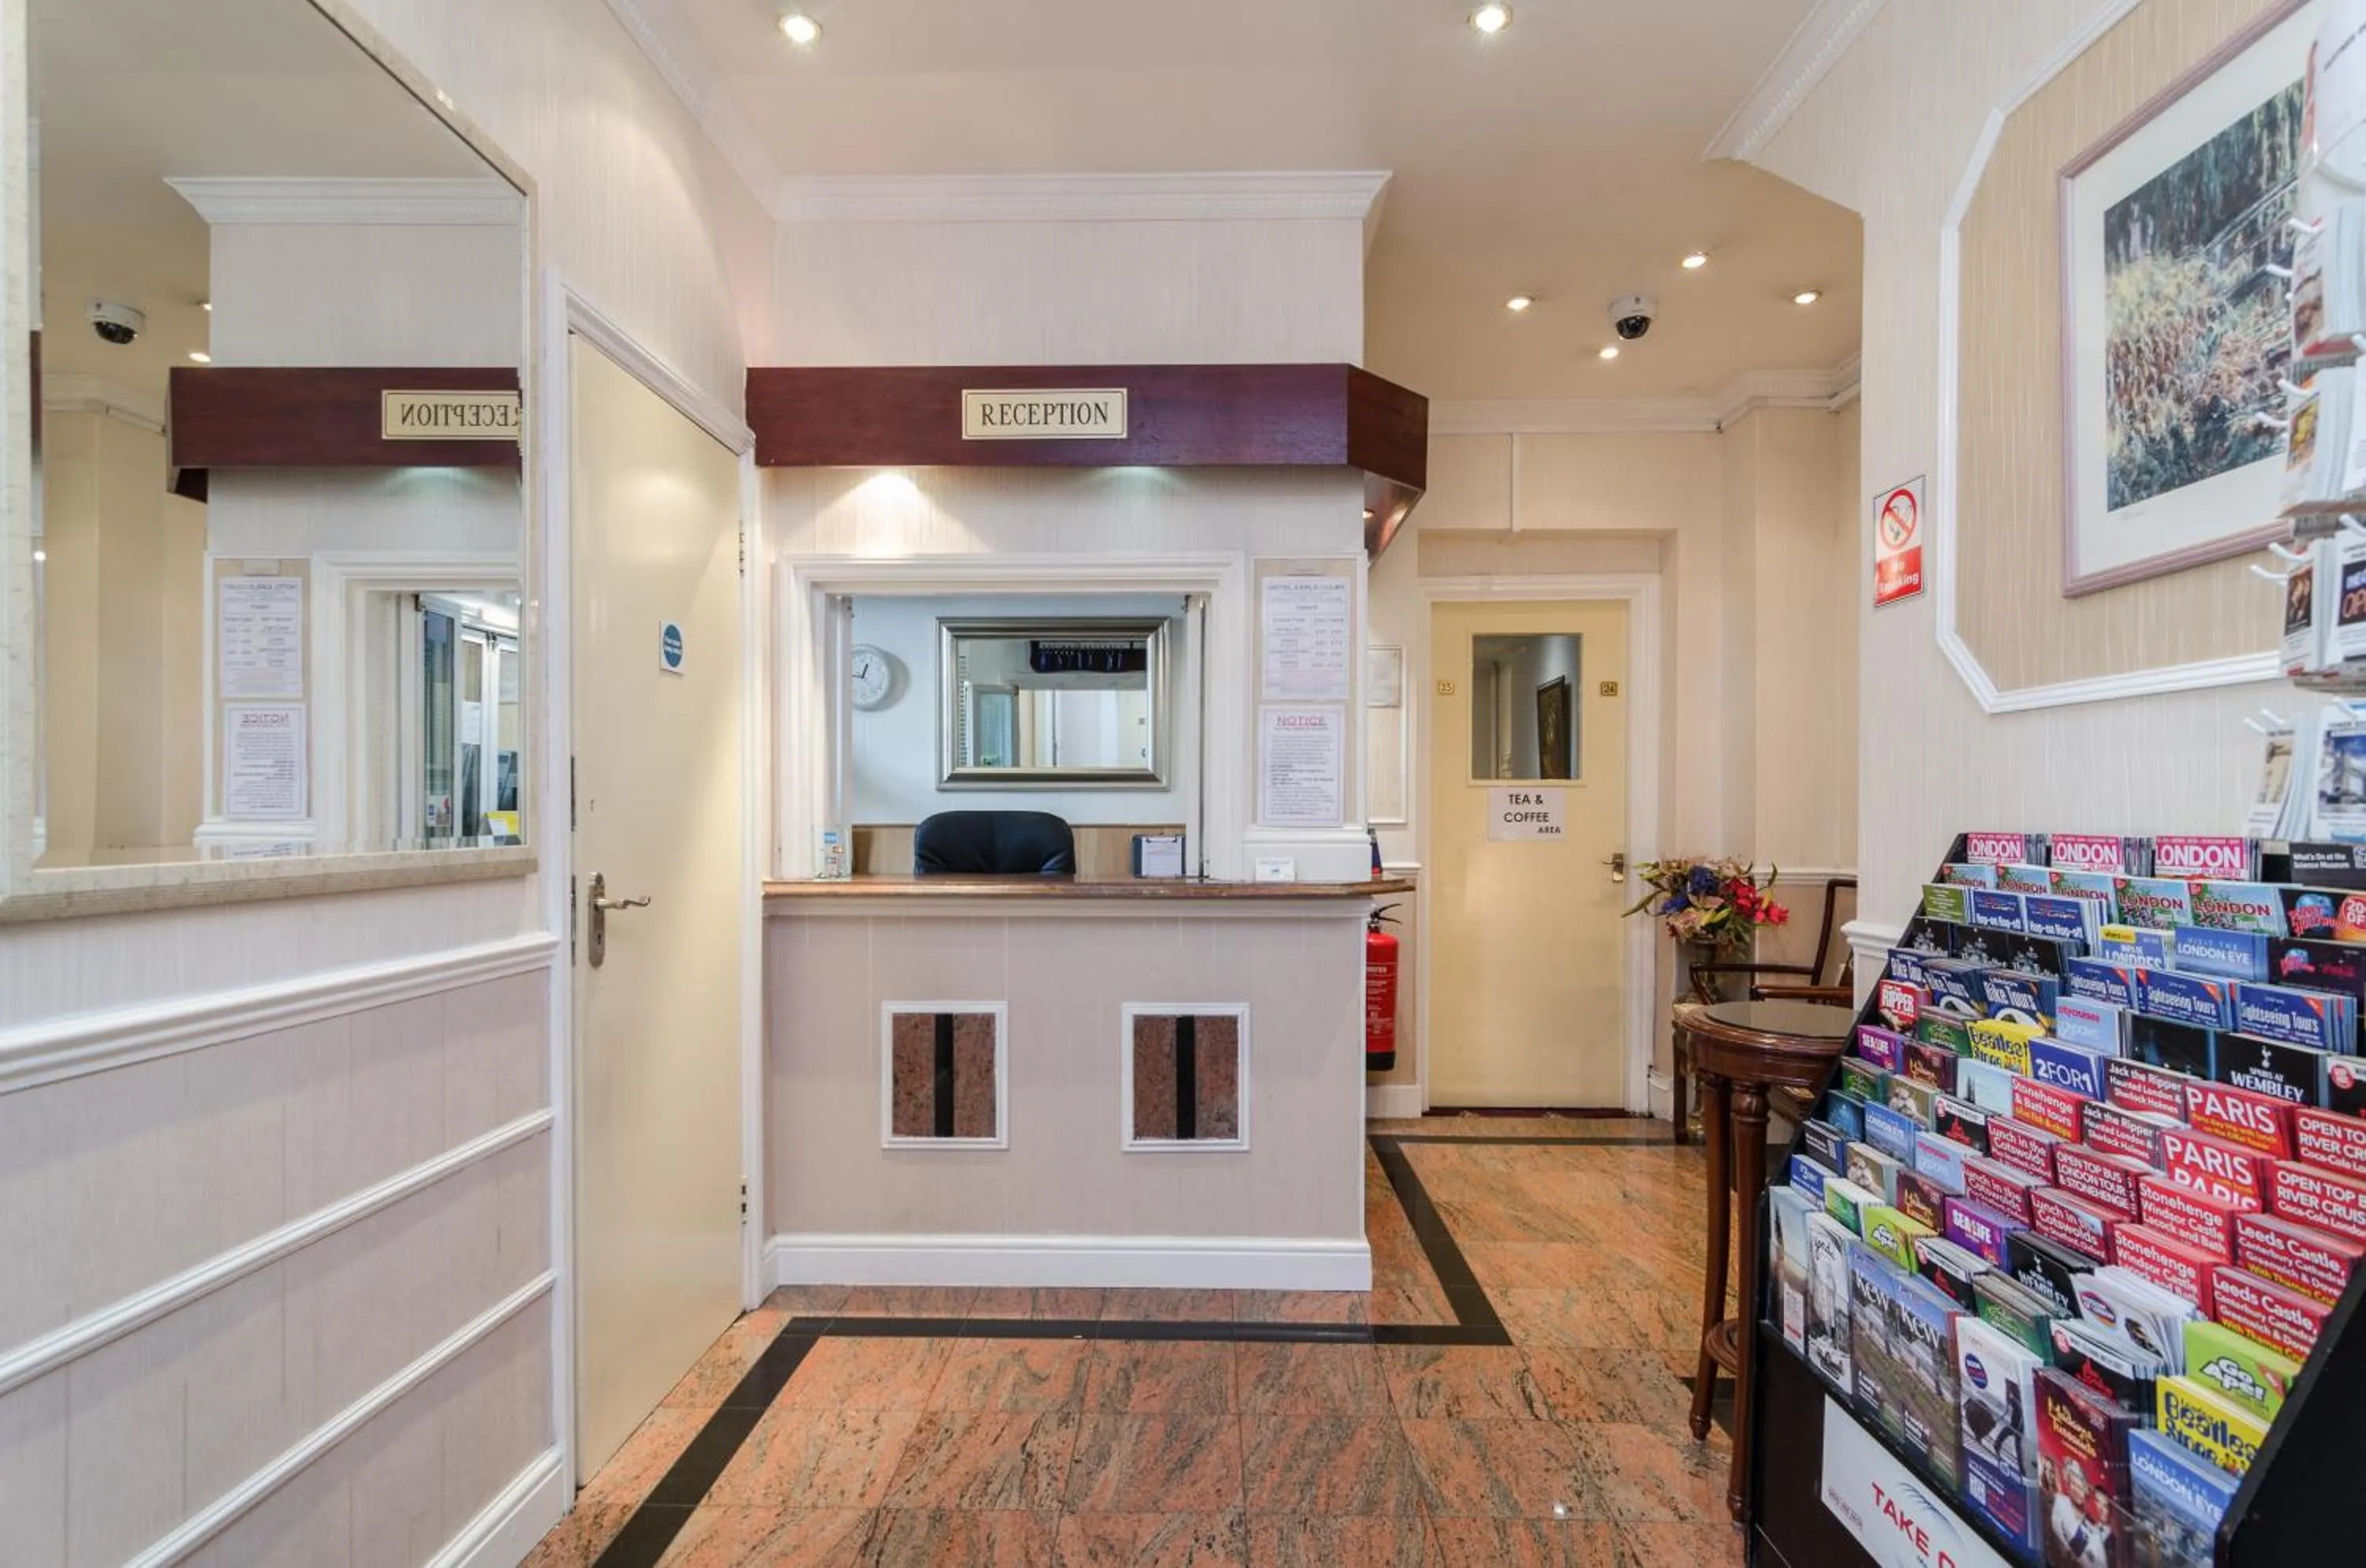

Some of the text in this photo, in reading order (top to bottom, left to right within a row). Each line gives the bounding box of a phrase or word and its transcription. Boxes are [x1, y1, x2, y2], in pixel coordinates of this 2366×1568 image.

[981, 401, 1109, 426] RECEPTION
[1604, 684, 1615, 694] 24
[1277, 715, 1327, 726] NOTICE
[1508, 793, 1543, 805] TEA &
[1503, 812, 1550, 823] COFFEE
[1968, 839, 2021, 859] LONDON
[2052, 842, 2118, 865] LONDON
[2155, 844, 2241, 868] LONDON
[2118, 892, 2184, 910] LONDON
[2194, 899, 2272, 917] LONDON
[2178, 944, 2252, 965] LONDON EYE
[1882, 987, 1914, 1014] RIPPER
[2034, 1057, 2094, 1092] 2FOR1
[2108, 1062, 2181, 1094] Jack the Ripper
[2109, 1075, 2142, 1093] Haunted
[2143, 1084, 2174, 1102] London
[2230, 1070, 2304, 1103] WEMBLEY
[2249, 1066, 2285, 1082] SPURS AT
[2012, 1078, 2073, 1114] Stonehenge
[2023, 1096, 2046, 1115] Bath
[2114, 1087, 2179, 1115] Sherlock Holmes
[2185, 1085, 2275, 1134] PARIS
[2083, 1107, 2154, 1139] Jack the Ripper
[2299, 1117, 2342, 1140] OPEN
[2343, 1127, 2366, 1145] TO
[1987, 1126, 2017, 1144] Lunch
[2028, 1140, 2047, 1157] the
[2298, 1132, 2342, 1155] RIVER
[2056, 1152, 2084, 1167] OPEN
[2084, 1159, 2102, 1174] TOP
[2103, 1167, 2122, 1183] BUS
[2163, 1134, 2253, 1185] PARIS
[2058, 1163, 2099, 1185] LONDON
[2099, 1177, 2126, 1196] TOUR
[2277, 1170, 2356, 1203] OPEN TOP
[2032, 1193, 2064, 1217] Lunch
[2140, 1183, 2223, 1227] Stonehenge
[2141, 1198, 2225, 1242] Windsor Castle
[2277, 1185, 2366, 1226] RIVER CRUIS
[2277, 1200, 2330, 1224] Coca-Cola
[2237, 1219, 2285, 1250] Leeds
[2115, 1230, 2196, 1279] Stonehenge
[2238, 1236, 2346, 1286] Canterbury Cathedral
[2245, 1250, 2300, 1279] Greenwich
[2117, 1246, 2199, 1296] Windsor Castle
[2211, 1271, 2259, 1306] Leeds
[2219, 1305, 2271, 1335] Greenwich
[2163, 1391, 2258, 1461] Beatles
[2131, 1450, 2191, 1499] LONDON
[2189, 1488, 2223, 1521] EYE
[1870, 1480, 1930, 1559] TAKE
